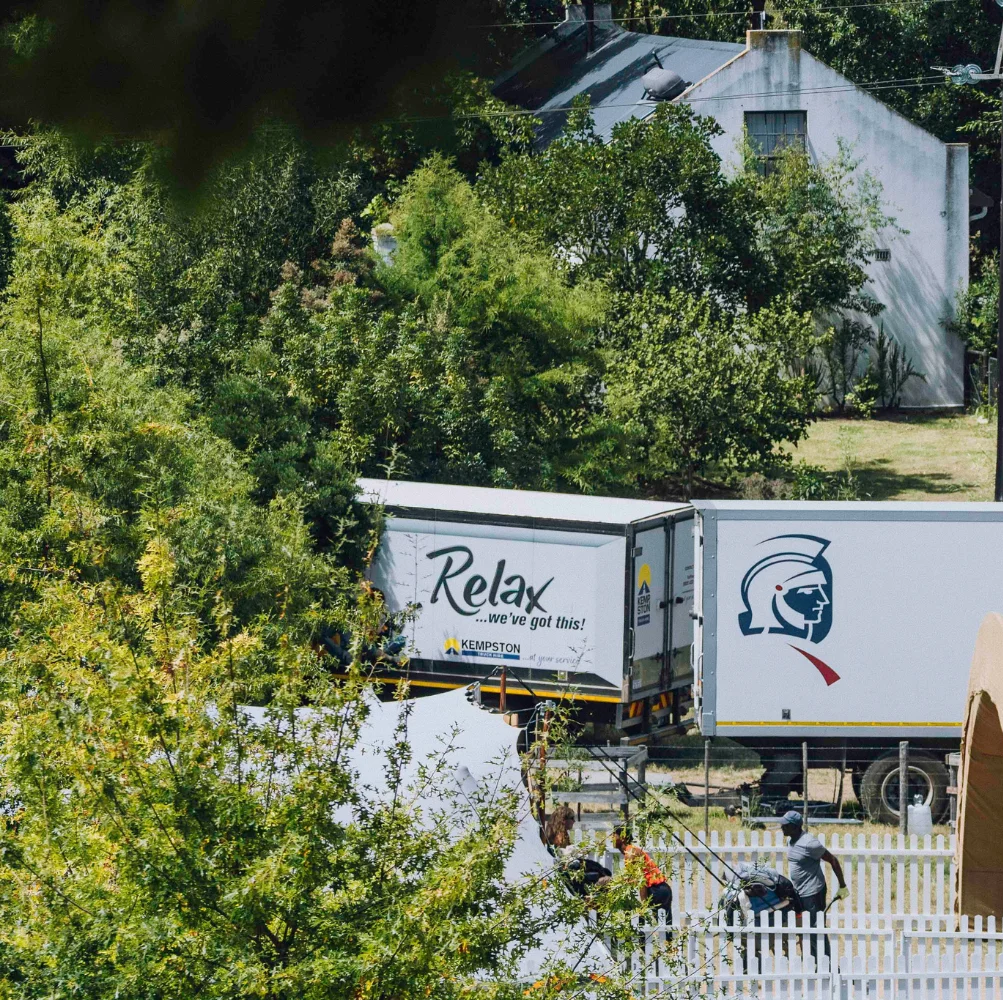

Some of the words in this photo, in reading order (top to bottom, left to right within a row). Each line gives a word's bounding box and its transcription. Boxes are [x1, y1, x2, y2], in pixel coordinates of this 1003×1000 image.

[426, 545, 554, 616] Relax
[637, 593, 651, 606] KEMP
[637, 602, 651, 615] STON
[476, 612, 526, 626] ...we've
[530, 616, 552, 631] got
[555, 616, 586, 631] this!
[461, 639, 521, 654] KEMPSTON
